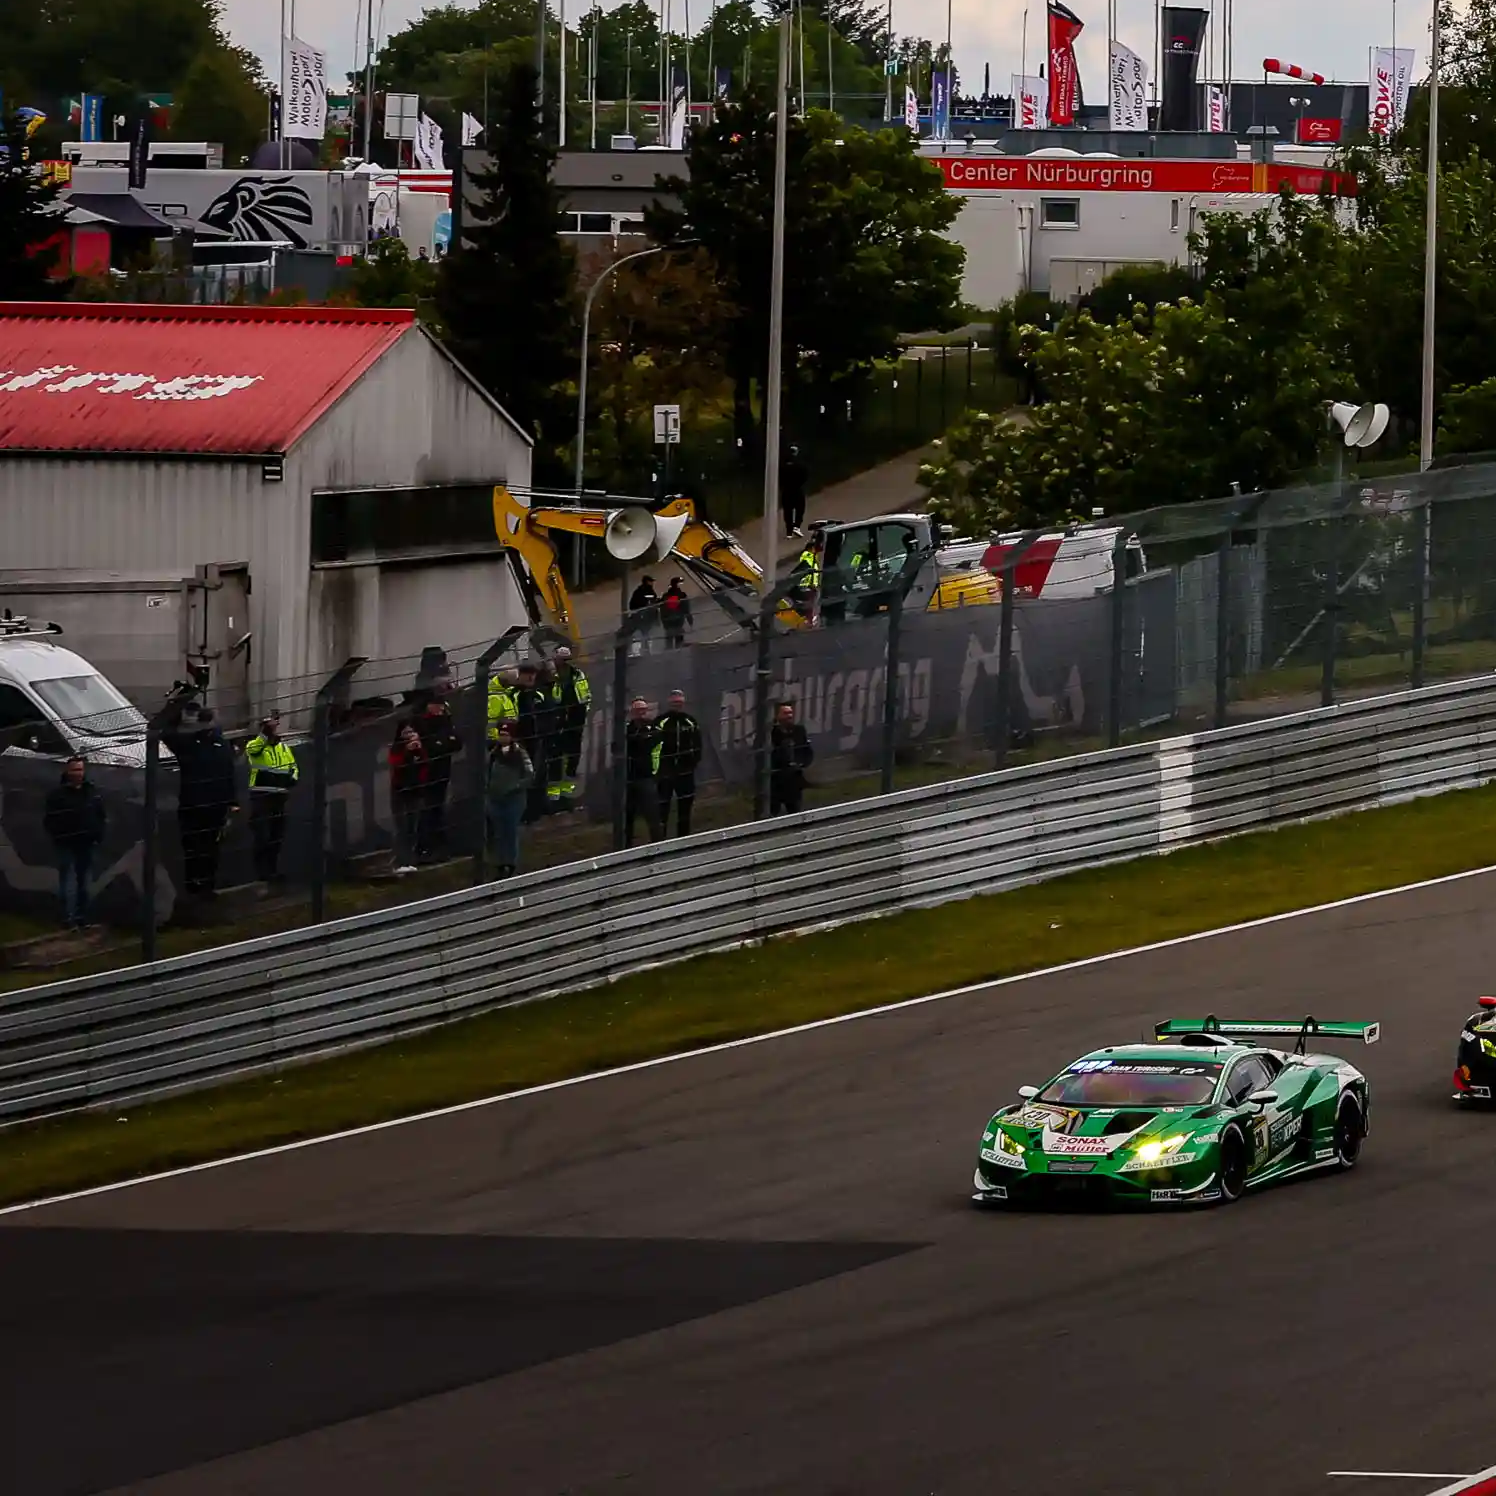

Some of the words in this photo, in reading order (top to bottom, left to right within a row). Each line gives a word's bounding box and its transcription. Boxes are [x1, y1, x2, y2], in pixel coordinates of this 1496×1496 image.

[950, 161, 1018, 182] Center
[1026, 163, 1153, 188] Nürburgring
[1056, 1136, 1108, 1144] SONAX
[1063, 1144, 1111, 1153] Müller
